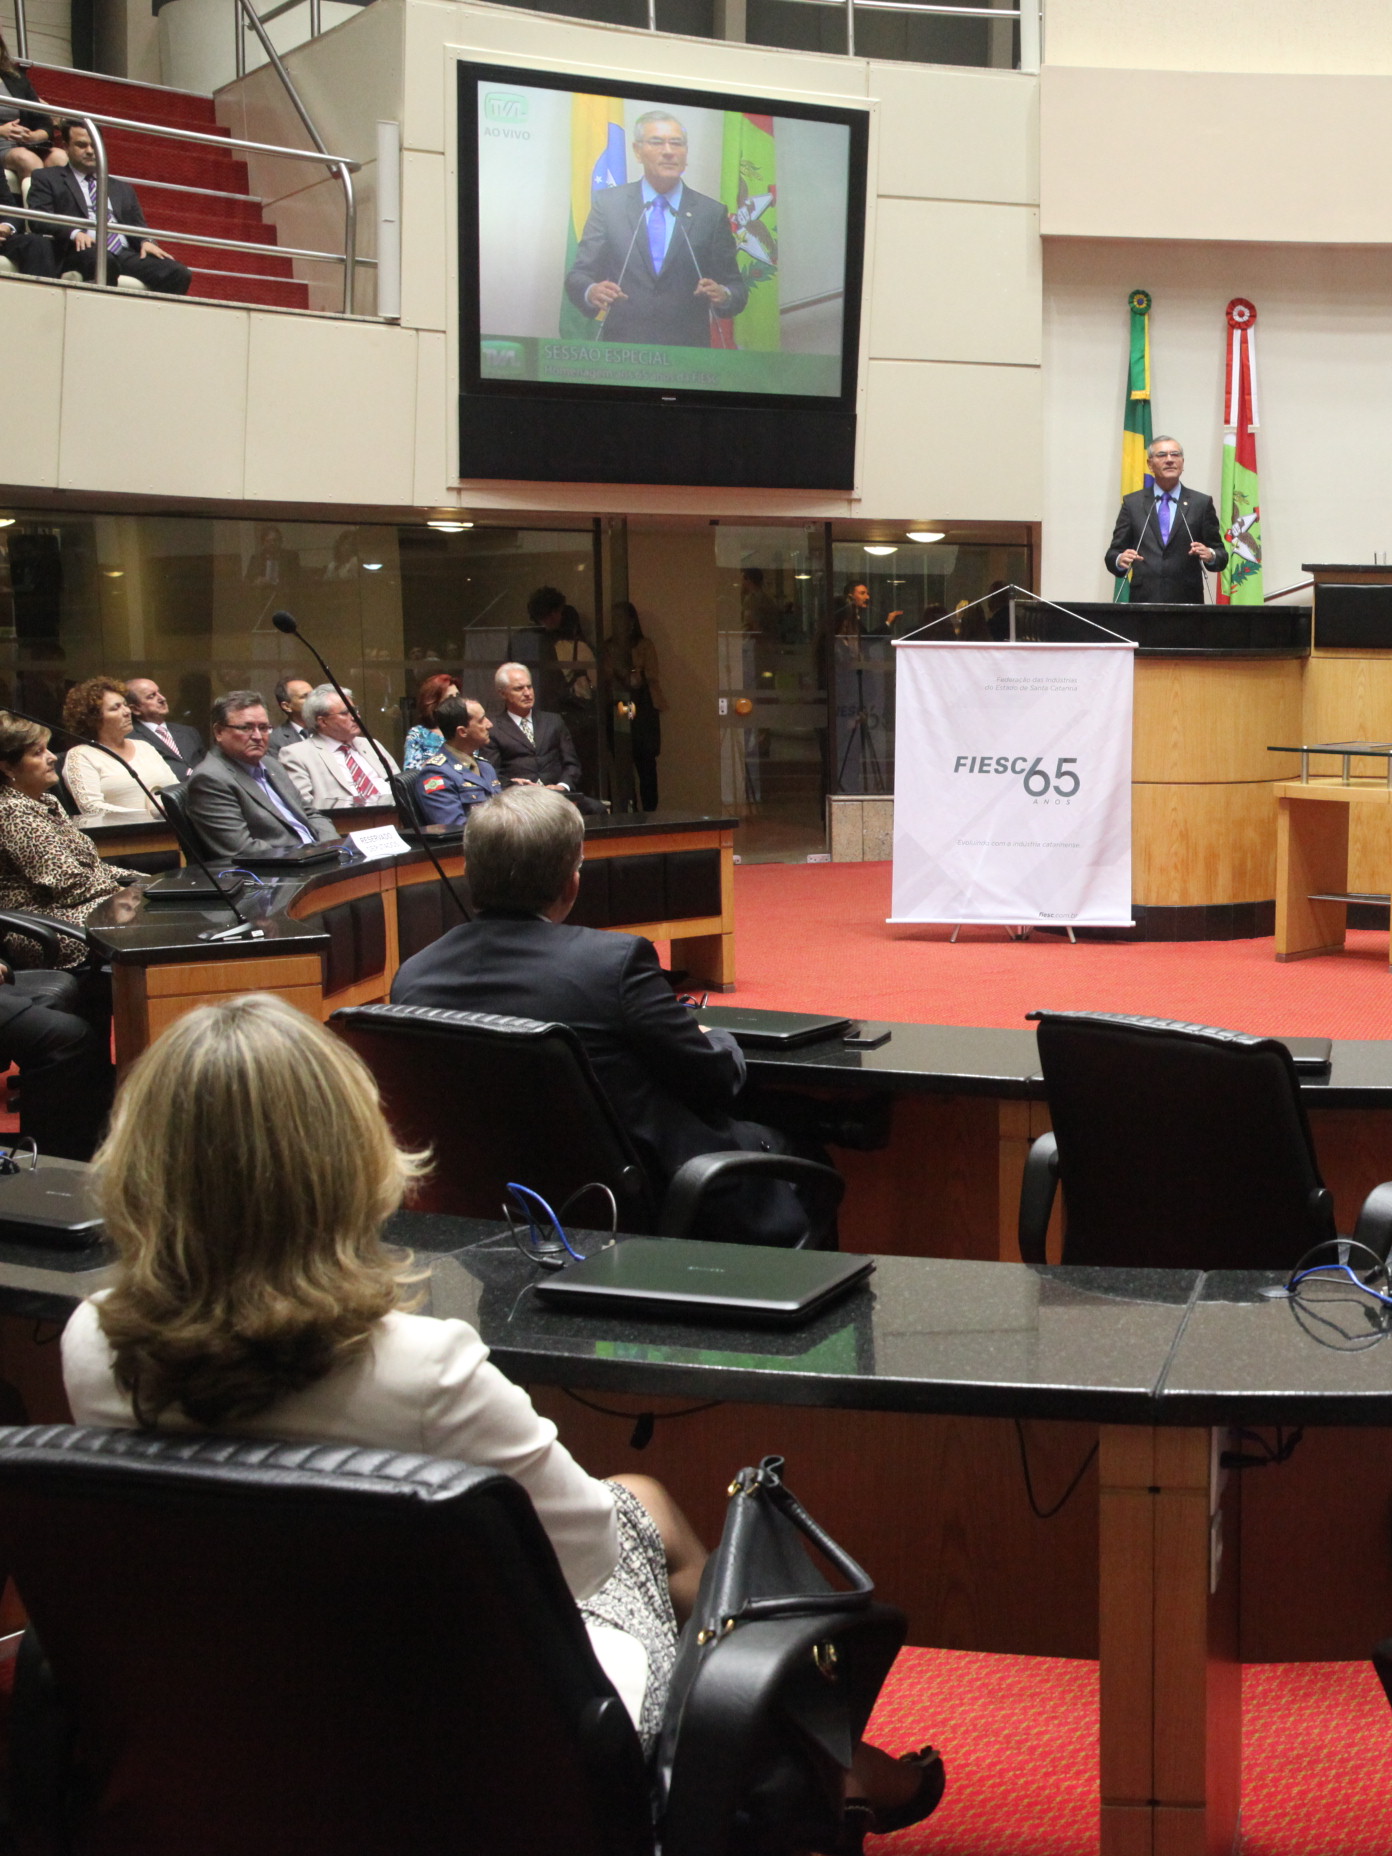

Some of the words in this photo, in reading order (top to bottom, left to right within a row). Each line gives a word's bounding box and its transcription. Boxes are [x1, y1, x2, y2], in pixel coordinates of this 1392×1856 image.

[484, 127, 501, 137] AO
[502, 128, 531, 141] VIVO
[605, 347, 671, 366] ESPECIAL
[544, 365, 614, 380] Homenagem
[1029, 684, 1049, 692] Santa
[953, 755, 1028, 775] FIESC
[1023, 756, 1080, 798] 65
[1032, 798, 1071, 806] ANOS
